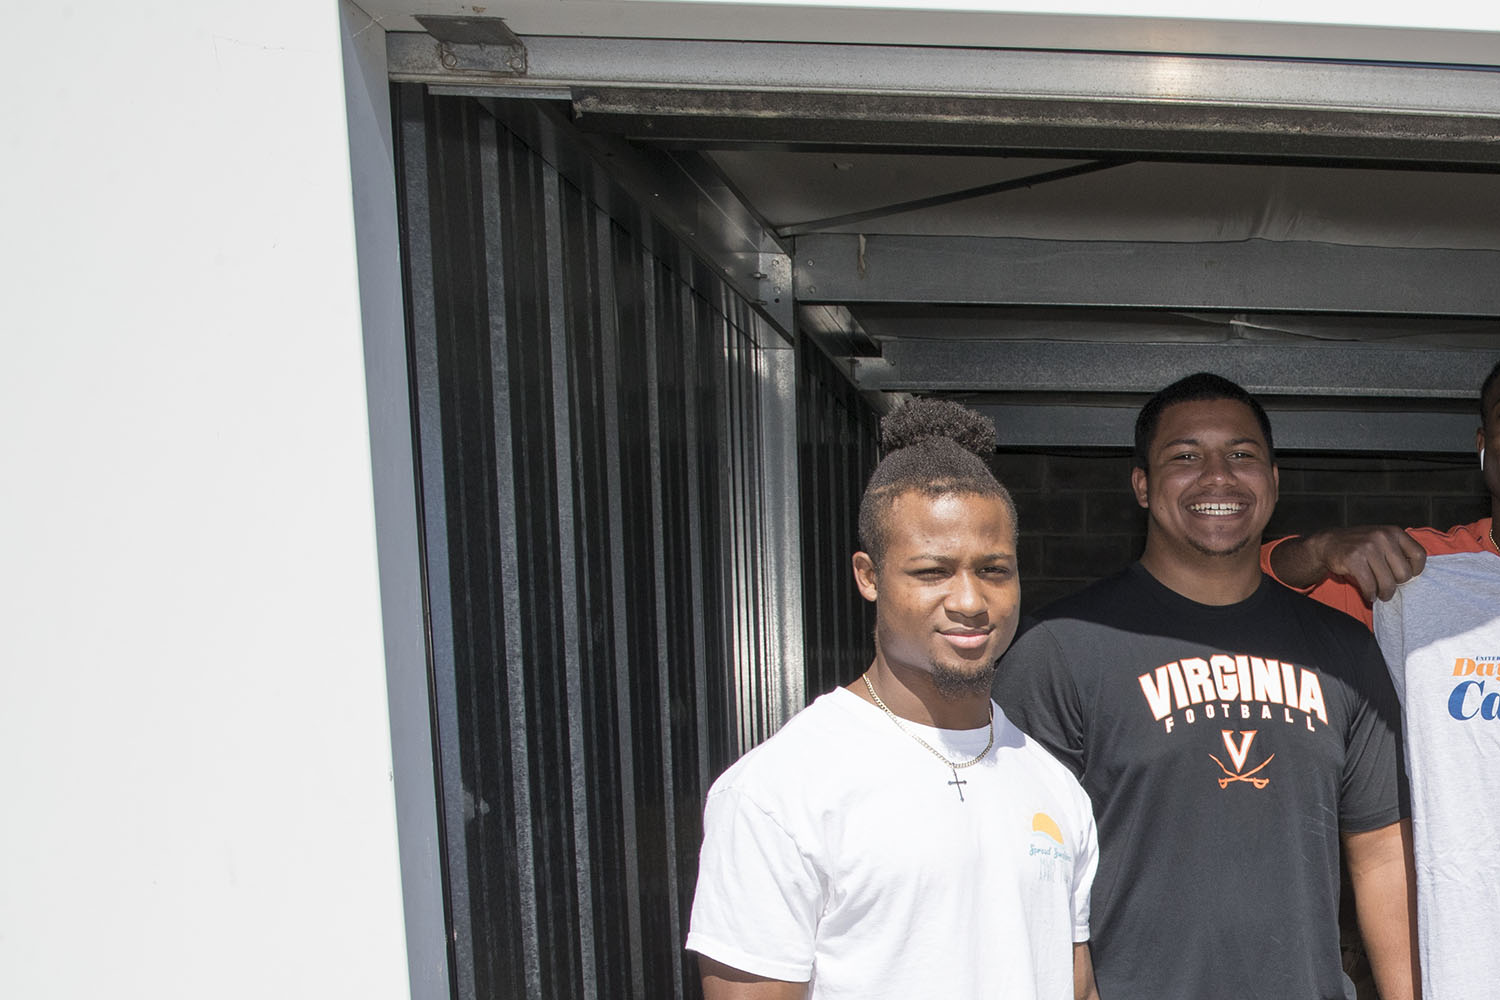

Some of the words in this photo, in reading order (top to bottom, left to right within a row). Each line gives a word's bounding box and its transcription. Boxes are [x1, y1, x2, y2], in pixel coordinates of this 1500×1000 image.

[1138, 654, 1329, 726] VIRGINIA
[1164, 703, 1316, 734] FOOTBALL
[1221, 729, 1258, 774] V
